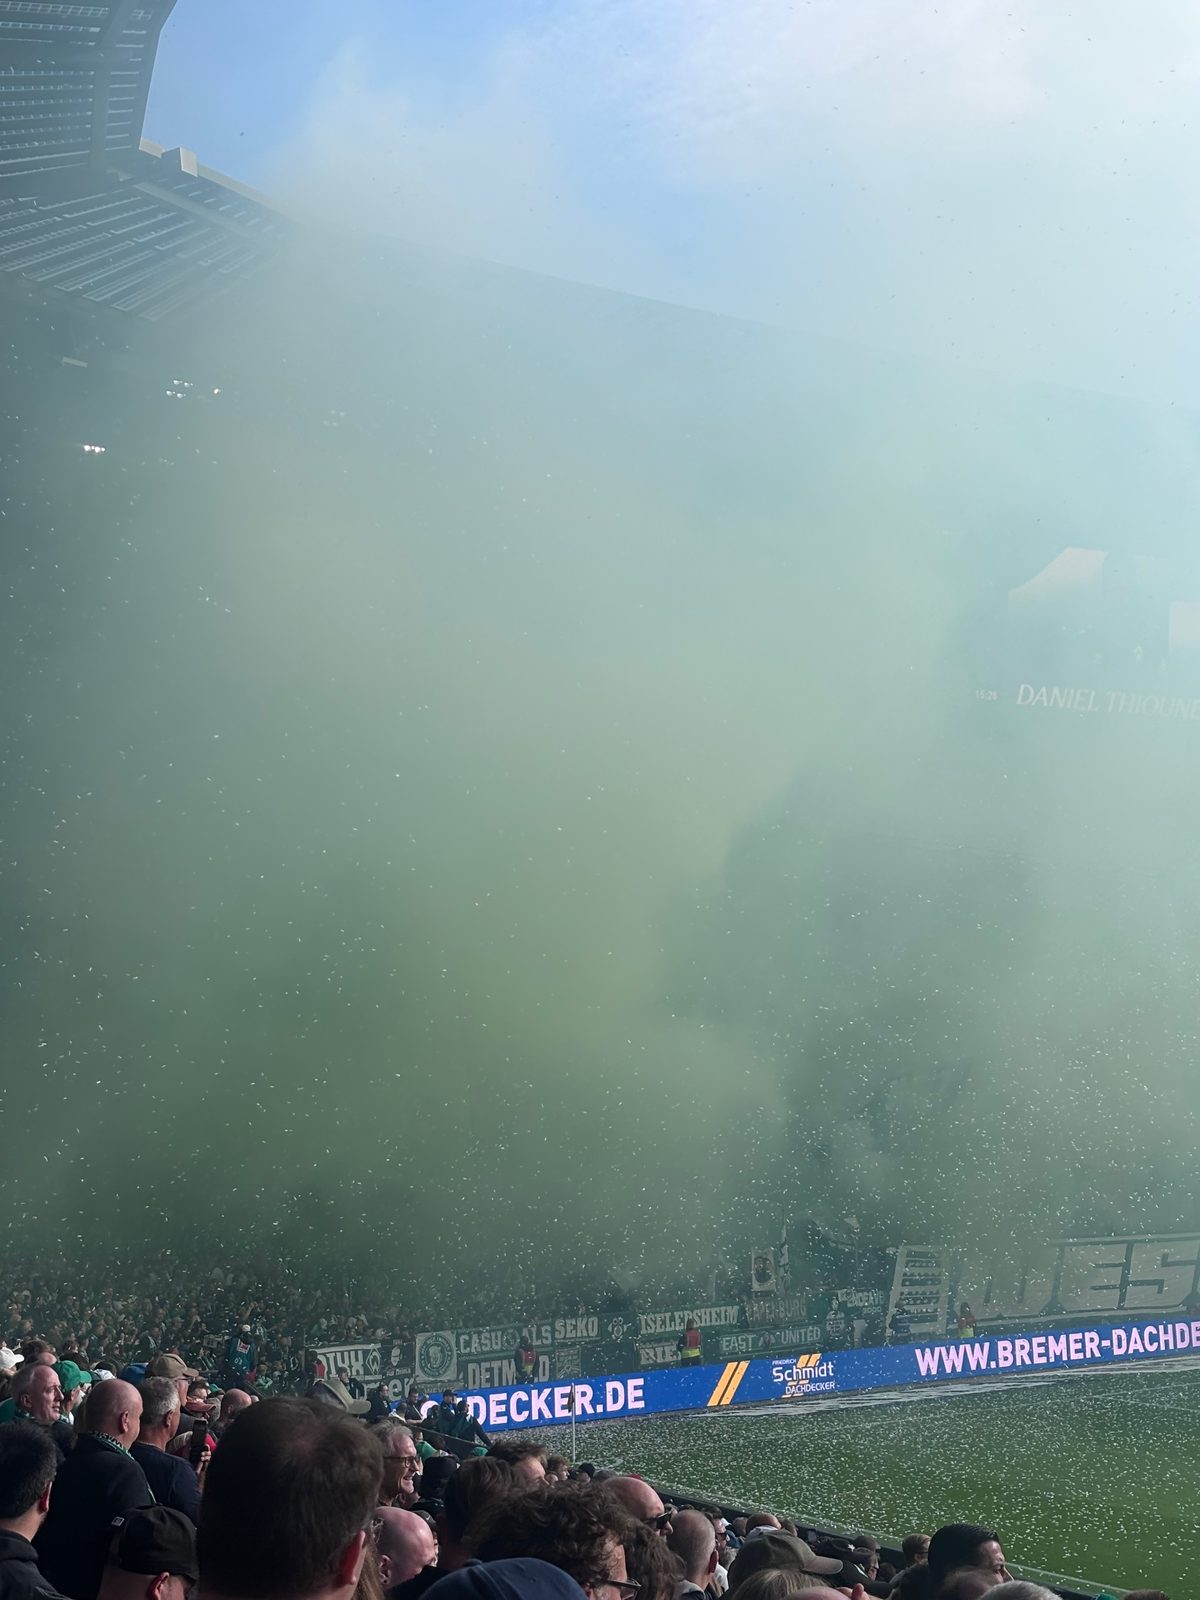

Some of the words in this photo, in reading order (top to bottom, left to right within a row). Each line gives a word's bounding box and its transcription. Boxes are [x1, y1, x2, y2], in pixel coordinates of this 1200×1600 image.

[1016, 683, 1099, 712] DANIEL
[554, 1316, 599, 1340] SEKO
[721, 1335, 753, 1352] EAST
[781, 1326, 821, 1345] UNITED
[468, 1354, 550, 1390] DETMD
[772, 1360, 834, 1382] Schmidt
[785, 1380, 836, 1395] DACHDECKER
